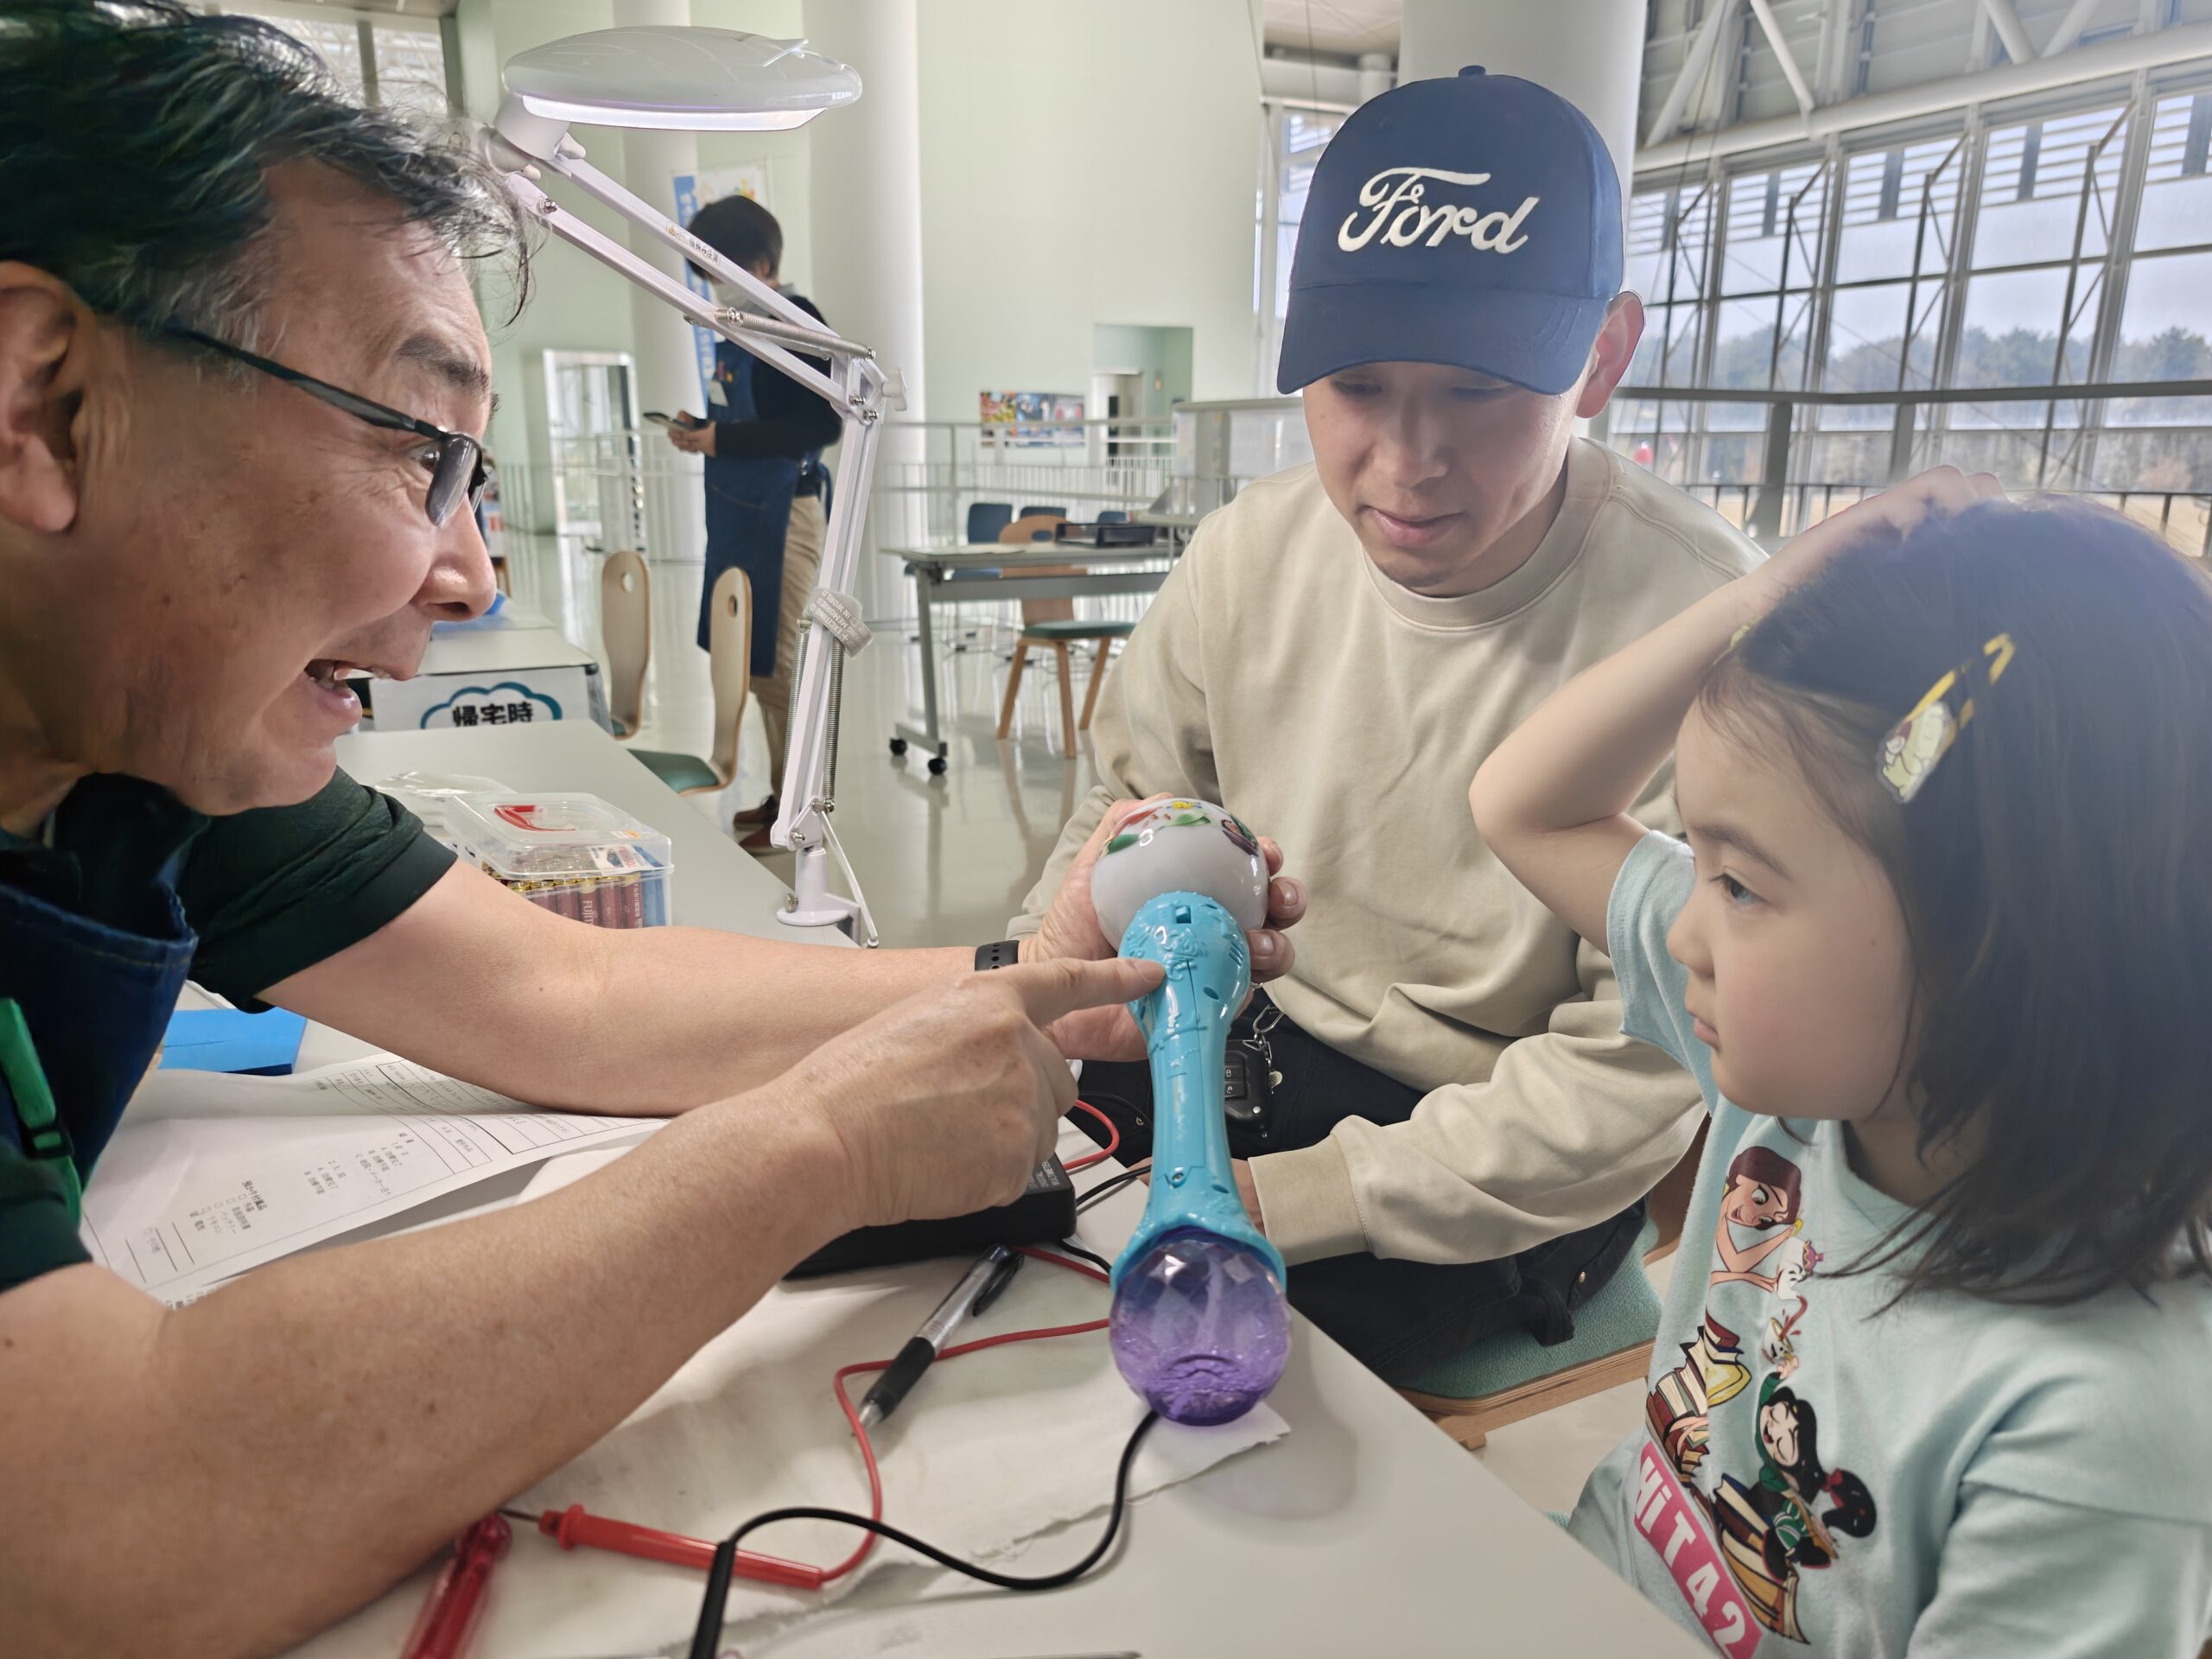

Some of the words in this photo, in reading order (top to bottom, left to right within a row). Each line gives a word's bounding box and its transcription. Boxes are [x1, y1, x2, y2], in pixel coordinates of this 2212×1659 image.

[1338, 167, 1541, 255] Ford
[452, 701, 533, 727] 帰宅時
